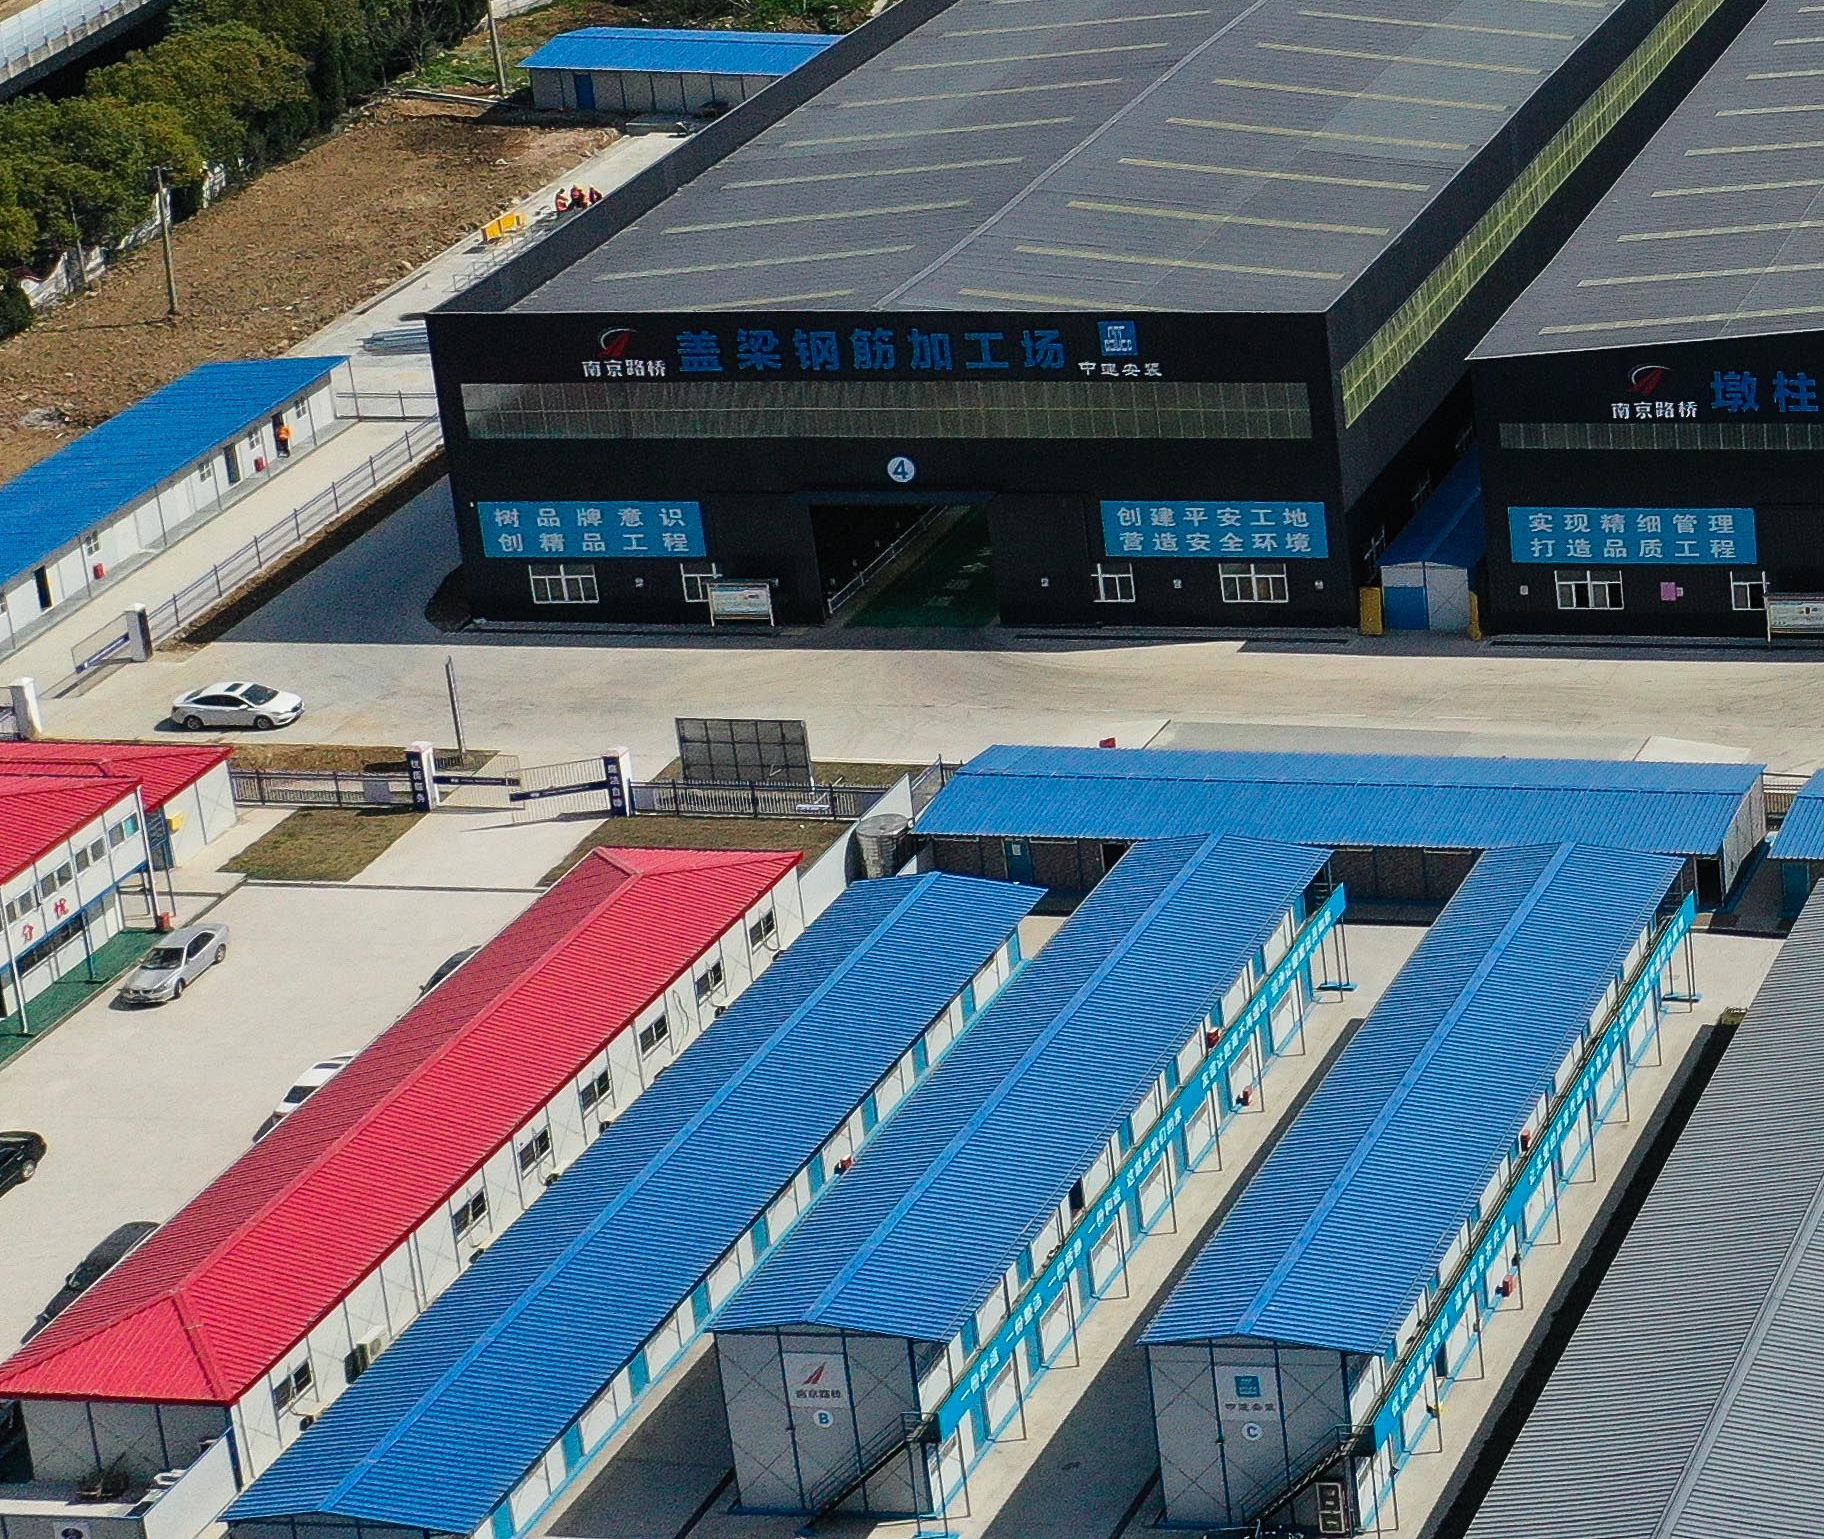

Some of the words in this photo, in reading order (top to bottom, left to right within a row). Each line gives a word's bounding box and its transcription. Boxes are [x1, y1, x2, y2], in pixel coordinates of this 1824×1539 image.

[677, 328, 1067, 374] 盖梁钢筋加工场
[582, 360, 668, 378] 南京路桥
[1079, 361, 1163, 377] 中建安装
[1611, 399, 1697, 418] 南京路桥
[893, 459, 909, 479] 4
[494, 507, 687, 530] 树品牌意识
[1116, 506, 1309, 530] 创建平安工地
[1528, 511, 1736, 534] 实现精细管理
[497, 532, 689, 553] 创精品工程
[1119, 532, 1312, 554] 营造安全环境
[1530, 537, 1737, 560] 打造品质工程
[818, 1412, 829, 1424] B
[1246, 1426, 1259, 1438] C
